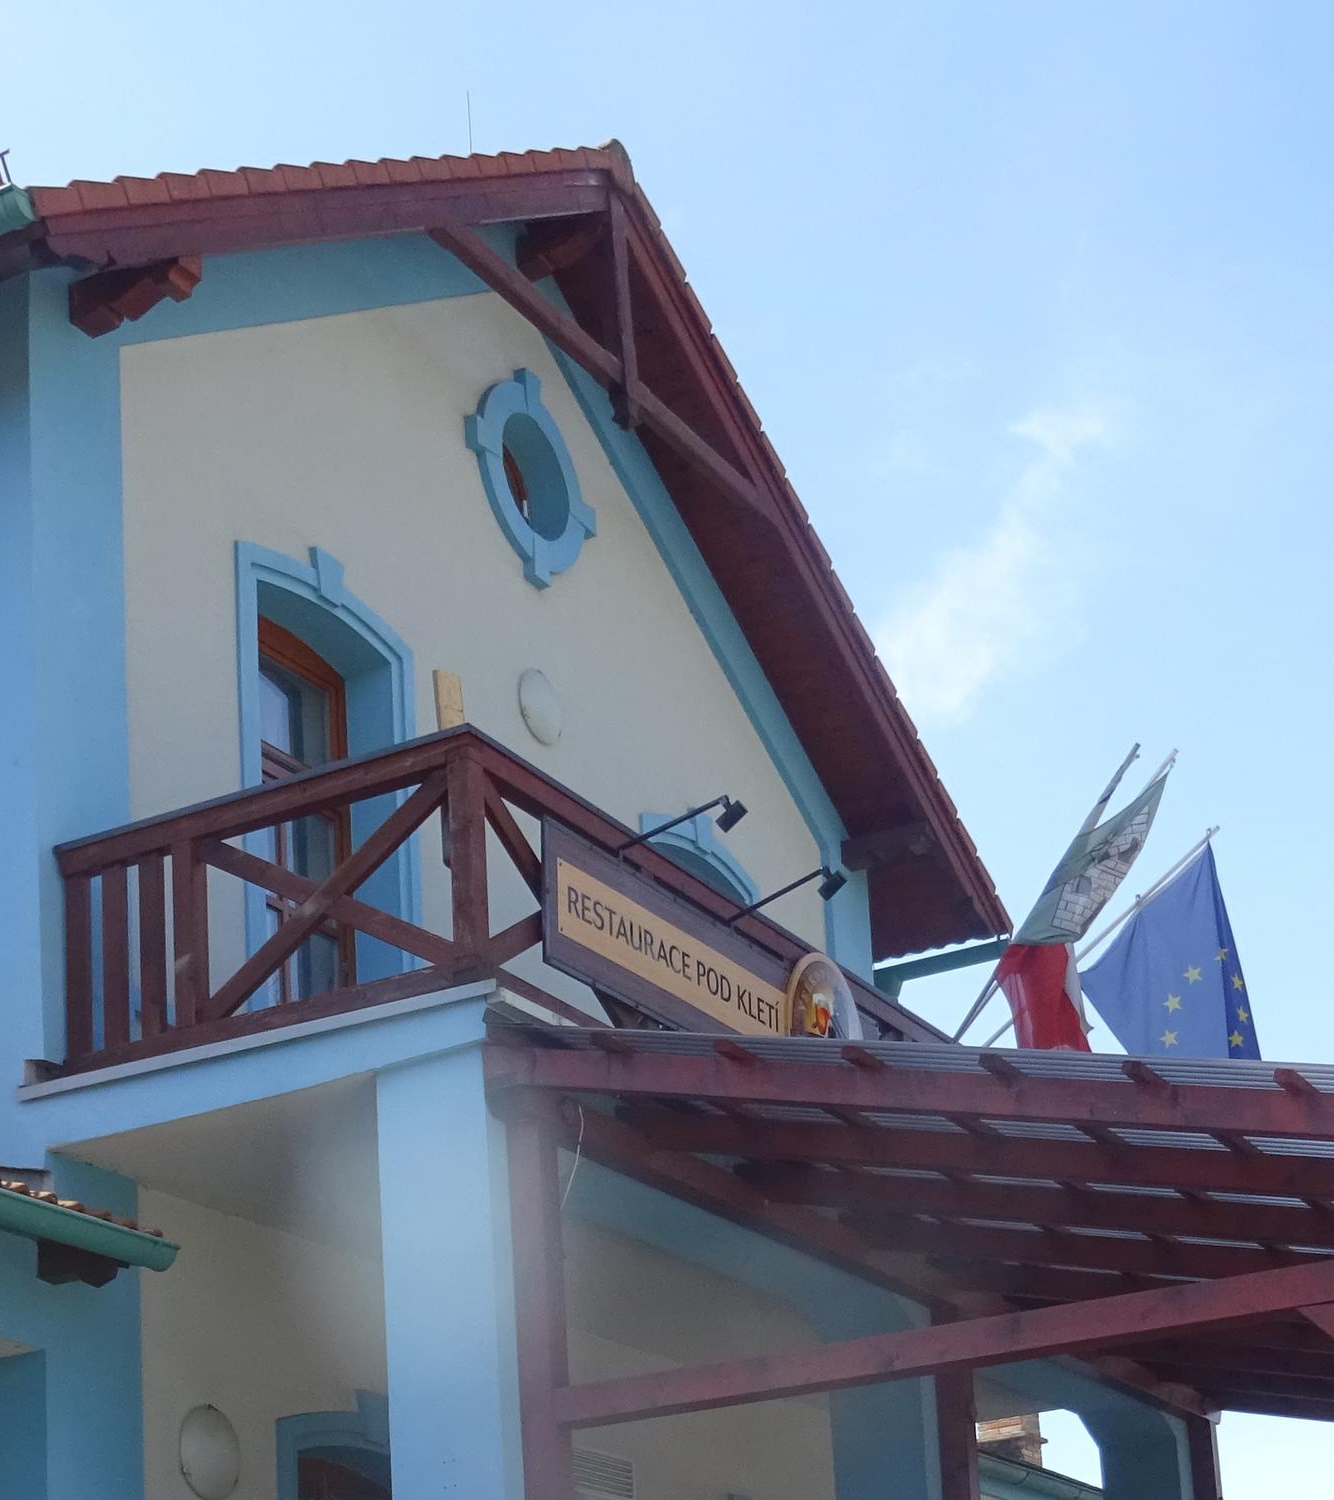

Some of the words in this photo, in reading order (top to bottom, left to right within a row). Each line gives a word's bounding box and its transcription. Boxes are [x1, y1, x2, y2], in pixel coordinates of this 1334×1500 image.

[567, 886, 692, 982] RESTAURACE
[696, 958, 732, 1004] POD
[737, 984, 780, 1034] KLETÍ
